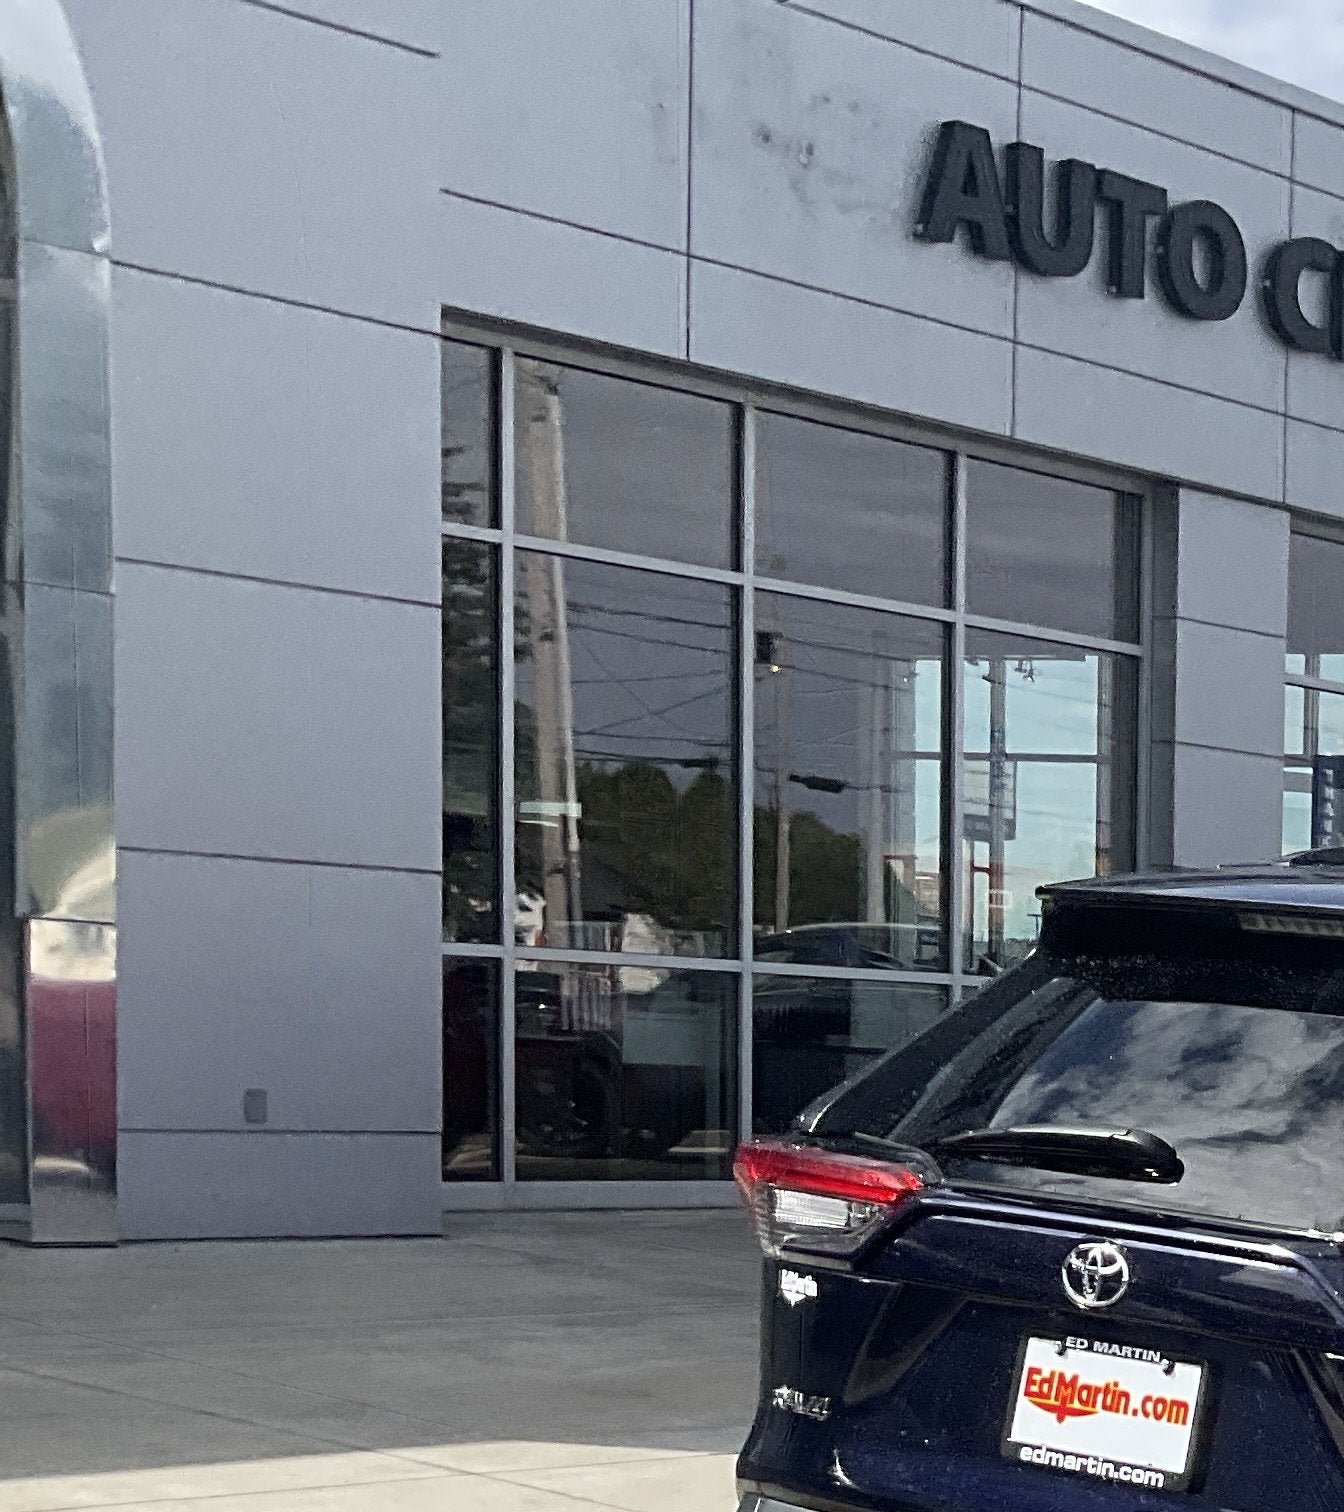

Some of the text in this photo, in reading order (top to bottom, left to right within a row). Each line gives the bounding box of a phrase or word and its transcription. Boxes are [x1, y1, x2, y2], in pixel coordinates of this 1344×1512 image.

[912, 118, 1248, 322] AUTO
[1065, 1336, 1161, 1363] ED MARTIN
[1019, 1444, 1165, 1488] edmartin.com
